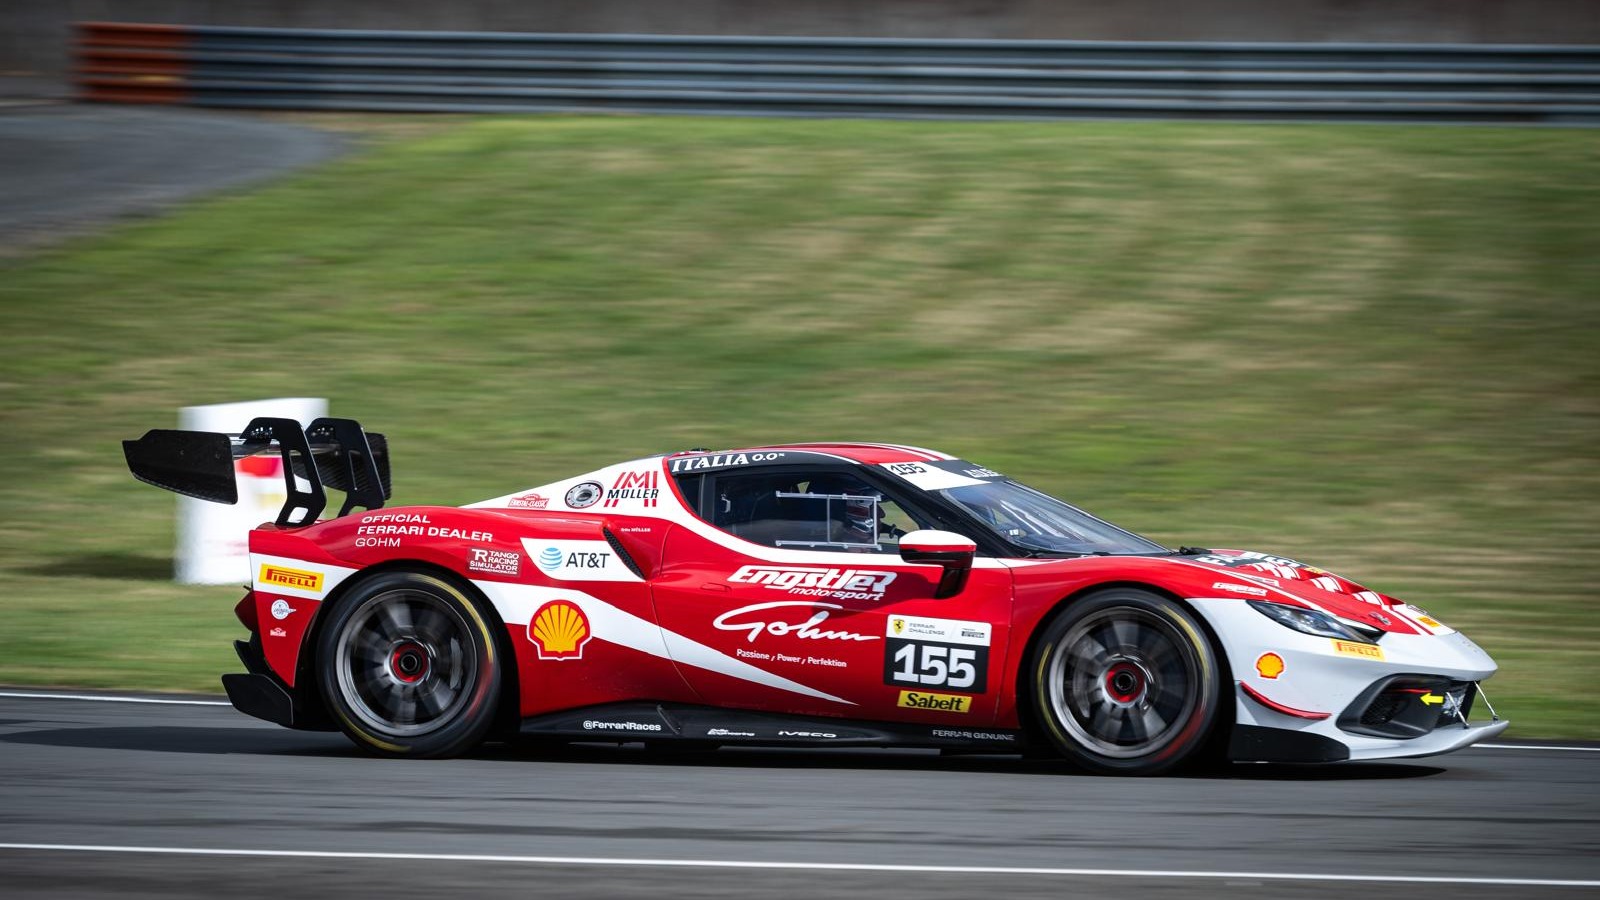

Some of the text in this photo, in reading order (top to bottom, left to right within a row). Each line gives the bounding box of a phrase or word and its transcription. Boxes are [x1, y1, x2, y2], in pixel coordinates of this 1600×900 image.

[672, 453, 749, 472] ITALIA
[890, 463, 927, 475] 155
[361, 514, 431, 524] OFFICIAL
[357, 525, 493, 542] FERRARI DEALER
[355, 537, 401, 547] GOHM
[488, 556, 519, 566] RACING
[489, 550, 519, 560] TANGO
[565, 552, 610, 568] AT&T
[470, 560, 518, 571] SIMULATOR
[266, 568, 317, 587] PIRELLI
[788, 587, 884, 601] motorsport
[713, 600, 881, 643] Gohm
[908, 628, 946, 636] CHALLENGE
[1335, 641, 1380, 657] PIRELLI
[736, 648, 770, 660] Passione
[777, 653, 801, 664] Power
[807, 656, 848, 668] Perfektion
[893, 643, 977, 688] 155
[905, 692, 963, 711] Sabelt
[583, 720, 662, 732] @FerrariRaces
[778, 730, 837, 738] IVECO
[932, 729, 1016, 741] FERRARI GENUINE
